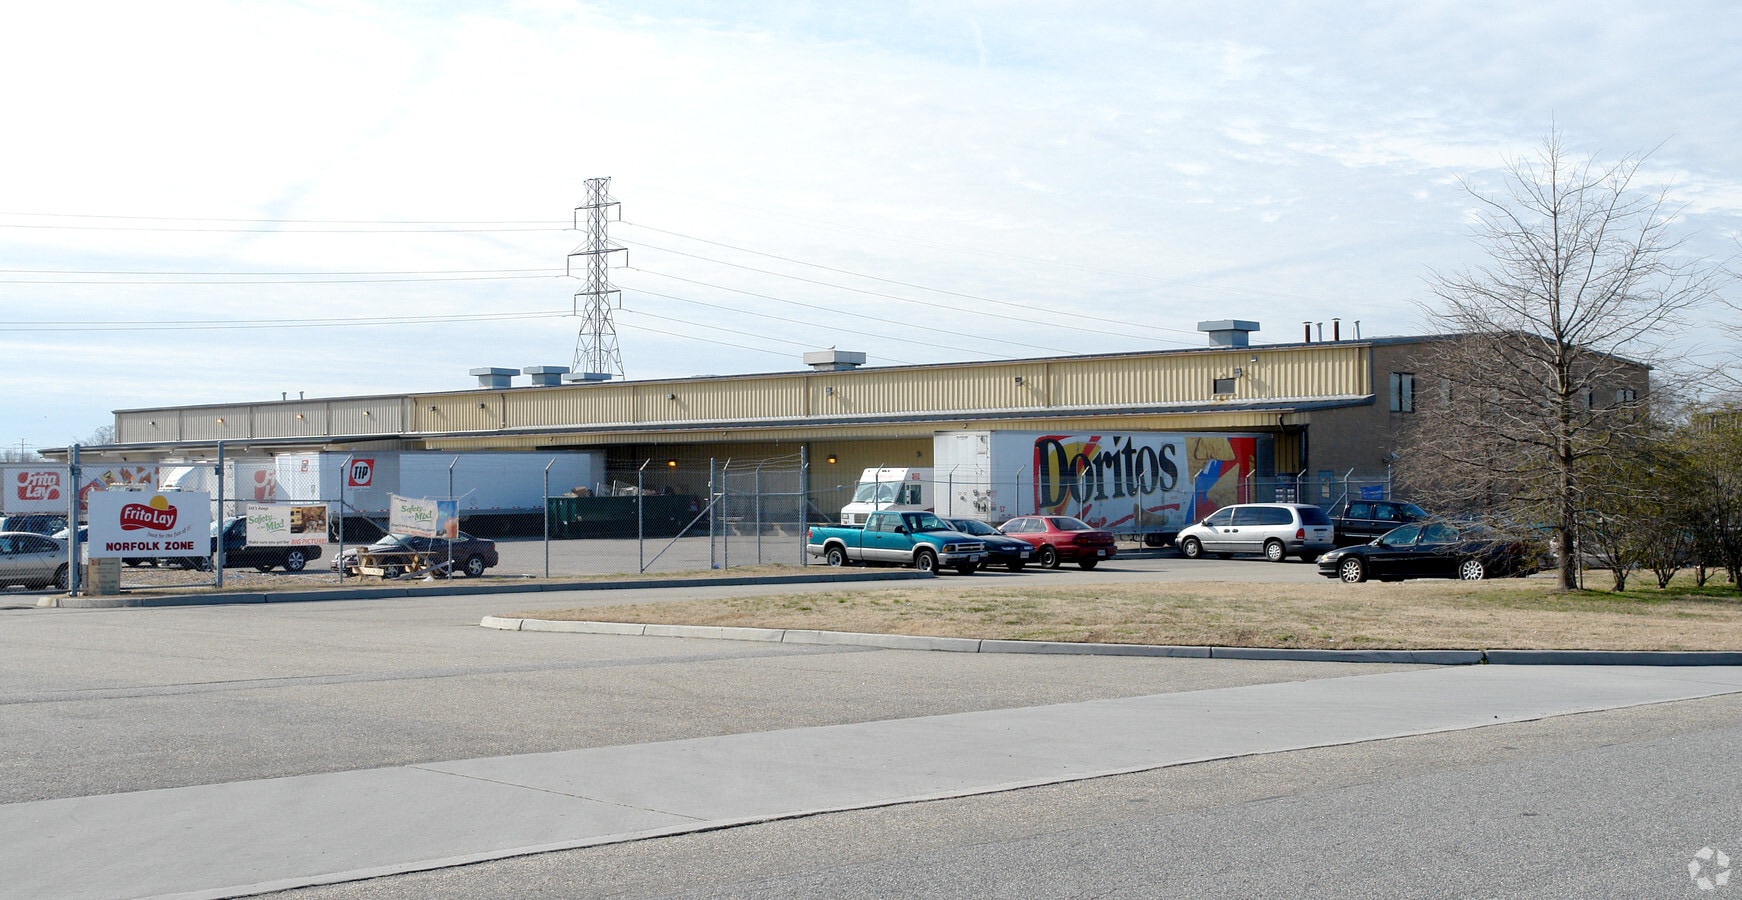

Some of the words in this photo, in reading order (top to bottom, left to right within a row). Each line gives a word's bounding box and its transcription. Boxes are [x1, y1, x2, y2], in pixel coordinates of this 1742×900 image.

[354, 466, 368, 479] TIP
[1036, 436, 1178, 508] Doritos
[124, 507, 152, 522] Frito
[153, 510, 174, 527] Lay
[106, 541, 160, 551] NORFOLK
[164, 541, 194, 550] ZONE
